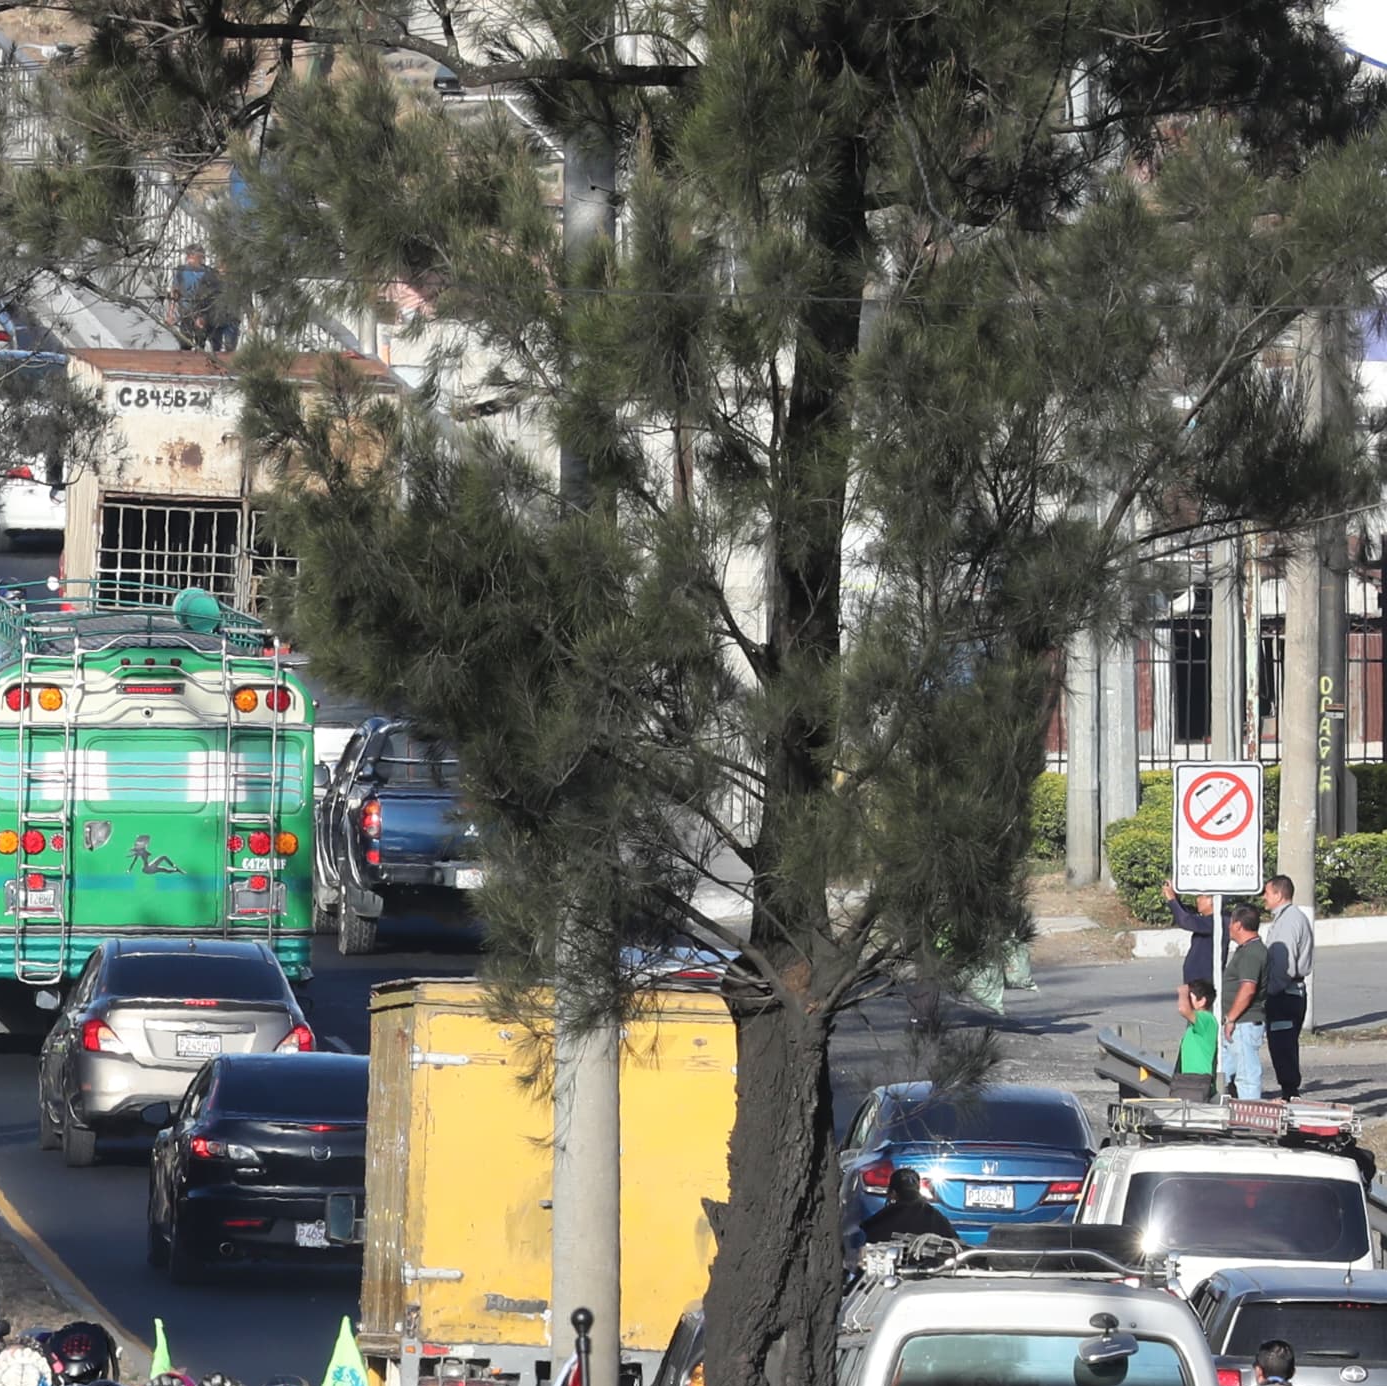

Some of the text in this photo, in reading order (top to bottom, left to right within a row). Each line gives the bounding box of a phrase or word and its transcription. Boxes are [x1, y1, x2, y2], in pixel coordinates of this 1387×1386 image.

[1188, 846, 1247, 858] PROHIBIDO USO
[1180, 864, 1255, 876] DE CELULAR MOTOS
